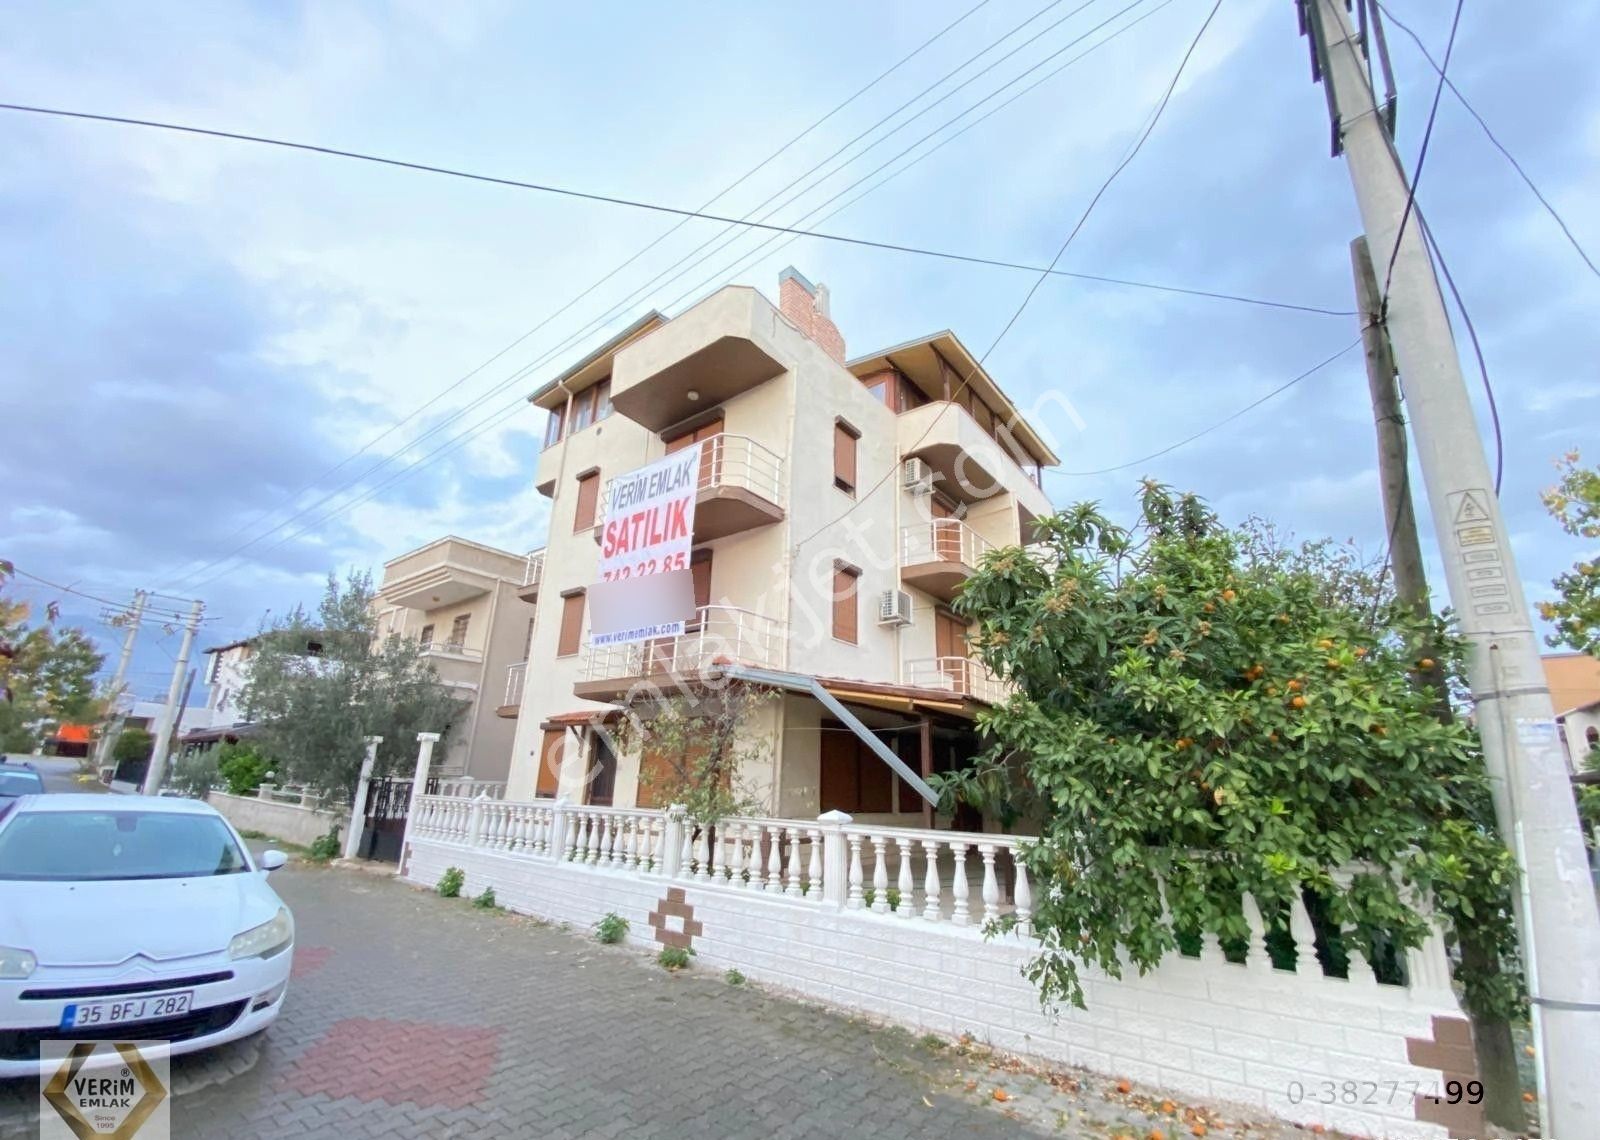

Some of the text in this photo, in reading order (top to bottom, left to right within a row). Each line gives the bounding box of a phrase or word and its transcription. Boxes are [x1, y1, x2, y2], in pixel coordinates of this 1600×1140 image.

[612, 461, 692, 511] VERİM EMLAK
[603, 496, 691, 559] SATILIK
[594, 622, 680, 645] www.verimemlak.com
[78, 996, 187, 1024] 35 BFJ 282
